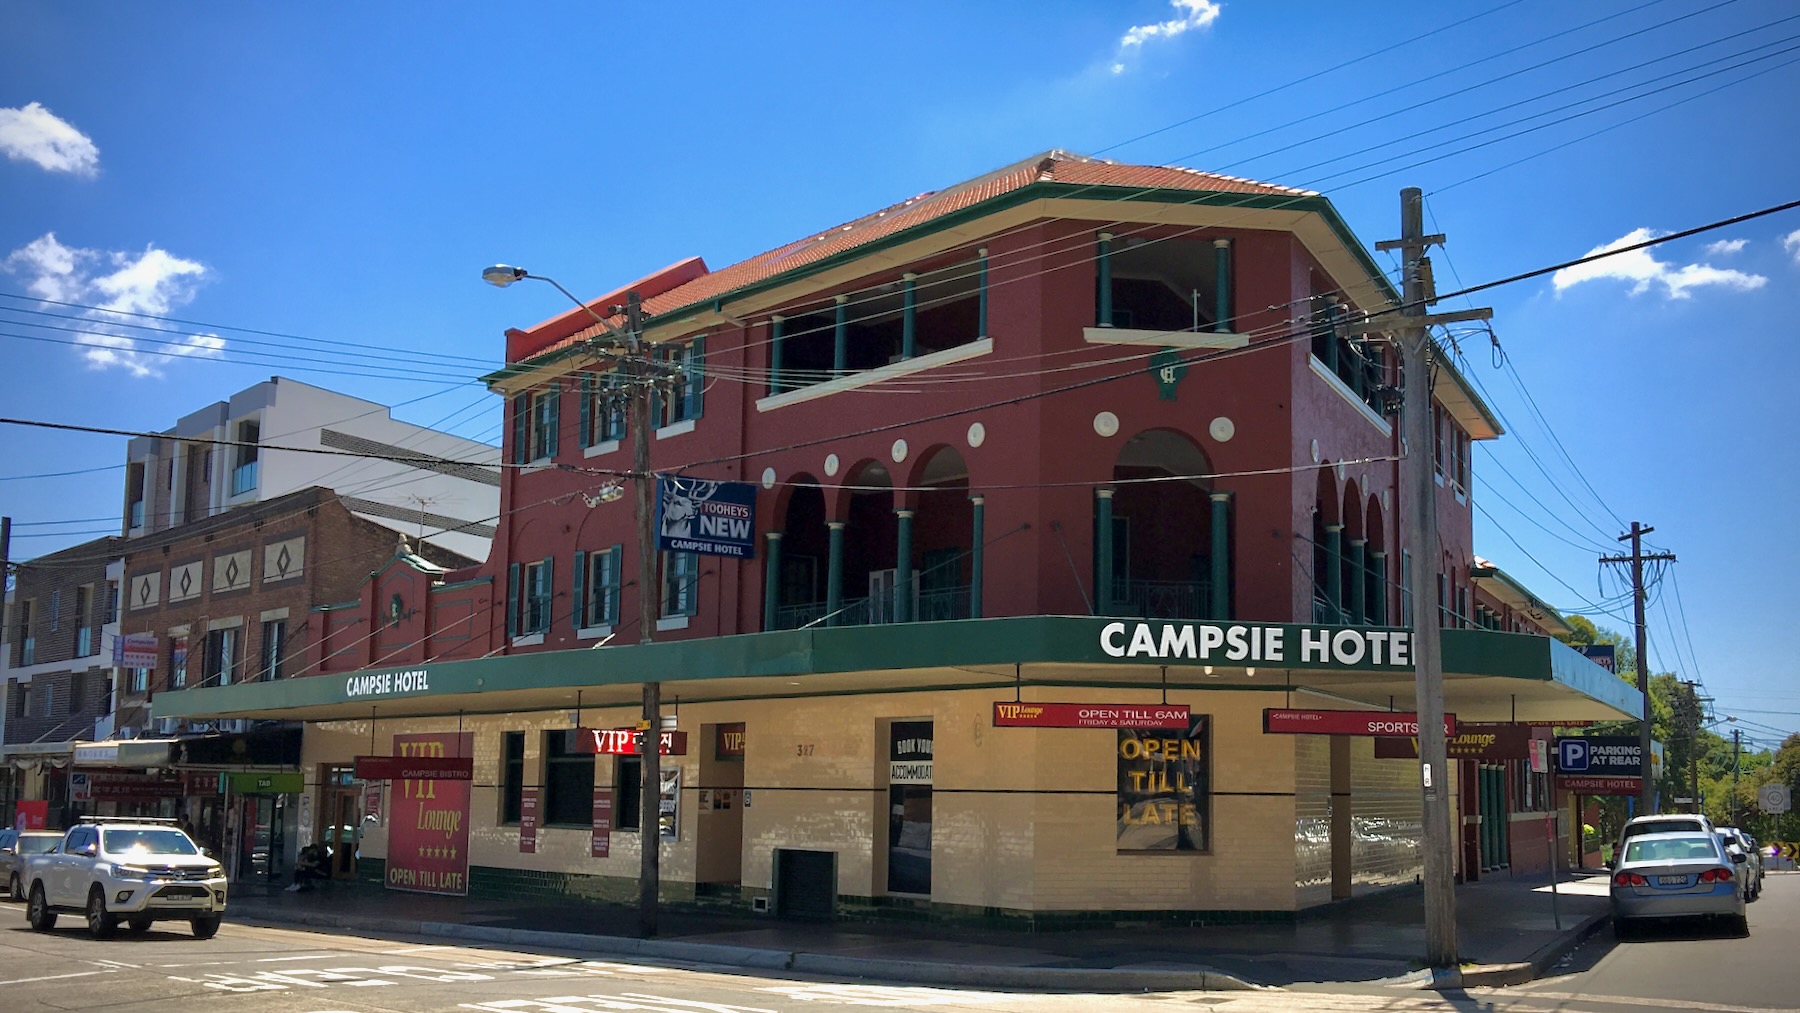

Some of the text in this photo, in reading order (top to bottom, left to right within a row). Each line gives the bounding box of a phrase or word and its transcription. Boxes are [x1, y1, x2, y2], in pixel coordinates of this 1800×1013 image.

[703, 502, 749, 518] TOOHEYS
[699, 515, 751, 540] NEW
[671, 539, 743, 555] CAMPSIE HOTEL
[1100, 621, 1416, 667] CAMPSIE HOTE
[346, 670, 429, 697] CAMPSIE HOTEL
[998, 704, 1044, 719] VIP Lounge
[1078, 709, 1187, 720] OPEN TILL 6AM
[1078, 718, 1108, 726] FRIDAY
[1119, 719, 1163, 727] SATURDAY
[1367, 721, 1419, 734] SPORTS
[592, 729, 629, 752] VIP
[724, 732, 741, 751] VIP
[897, 738, 916, 755] BOOK
[1119, 738, 1201, 761] OPEN
[1566, 743, 1584, 766] P
[1590, 745, 1641, 756] PARKING
[1591, 756, 1640, 766] AT REAR
[402, 769, 469, 779] CAMPSIE BISTRO
[1128, 769, 1193, 795] TILL
[1564, 779, 1636, 789] CAMPSIE HOTEL
[417, 801, 462, 839] Lounge
[1123, 802, 1197, 826] LATE
[390, 867, 462, 890] OPEN TILL LATE
